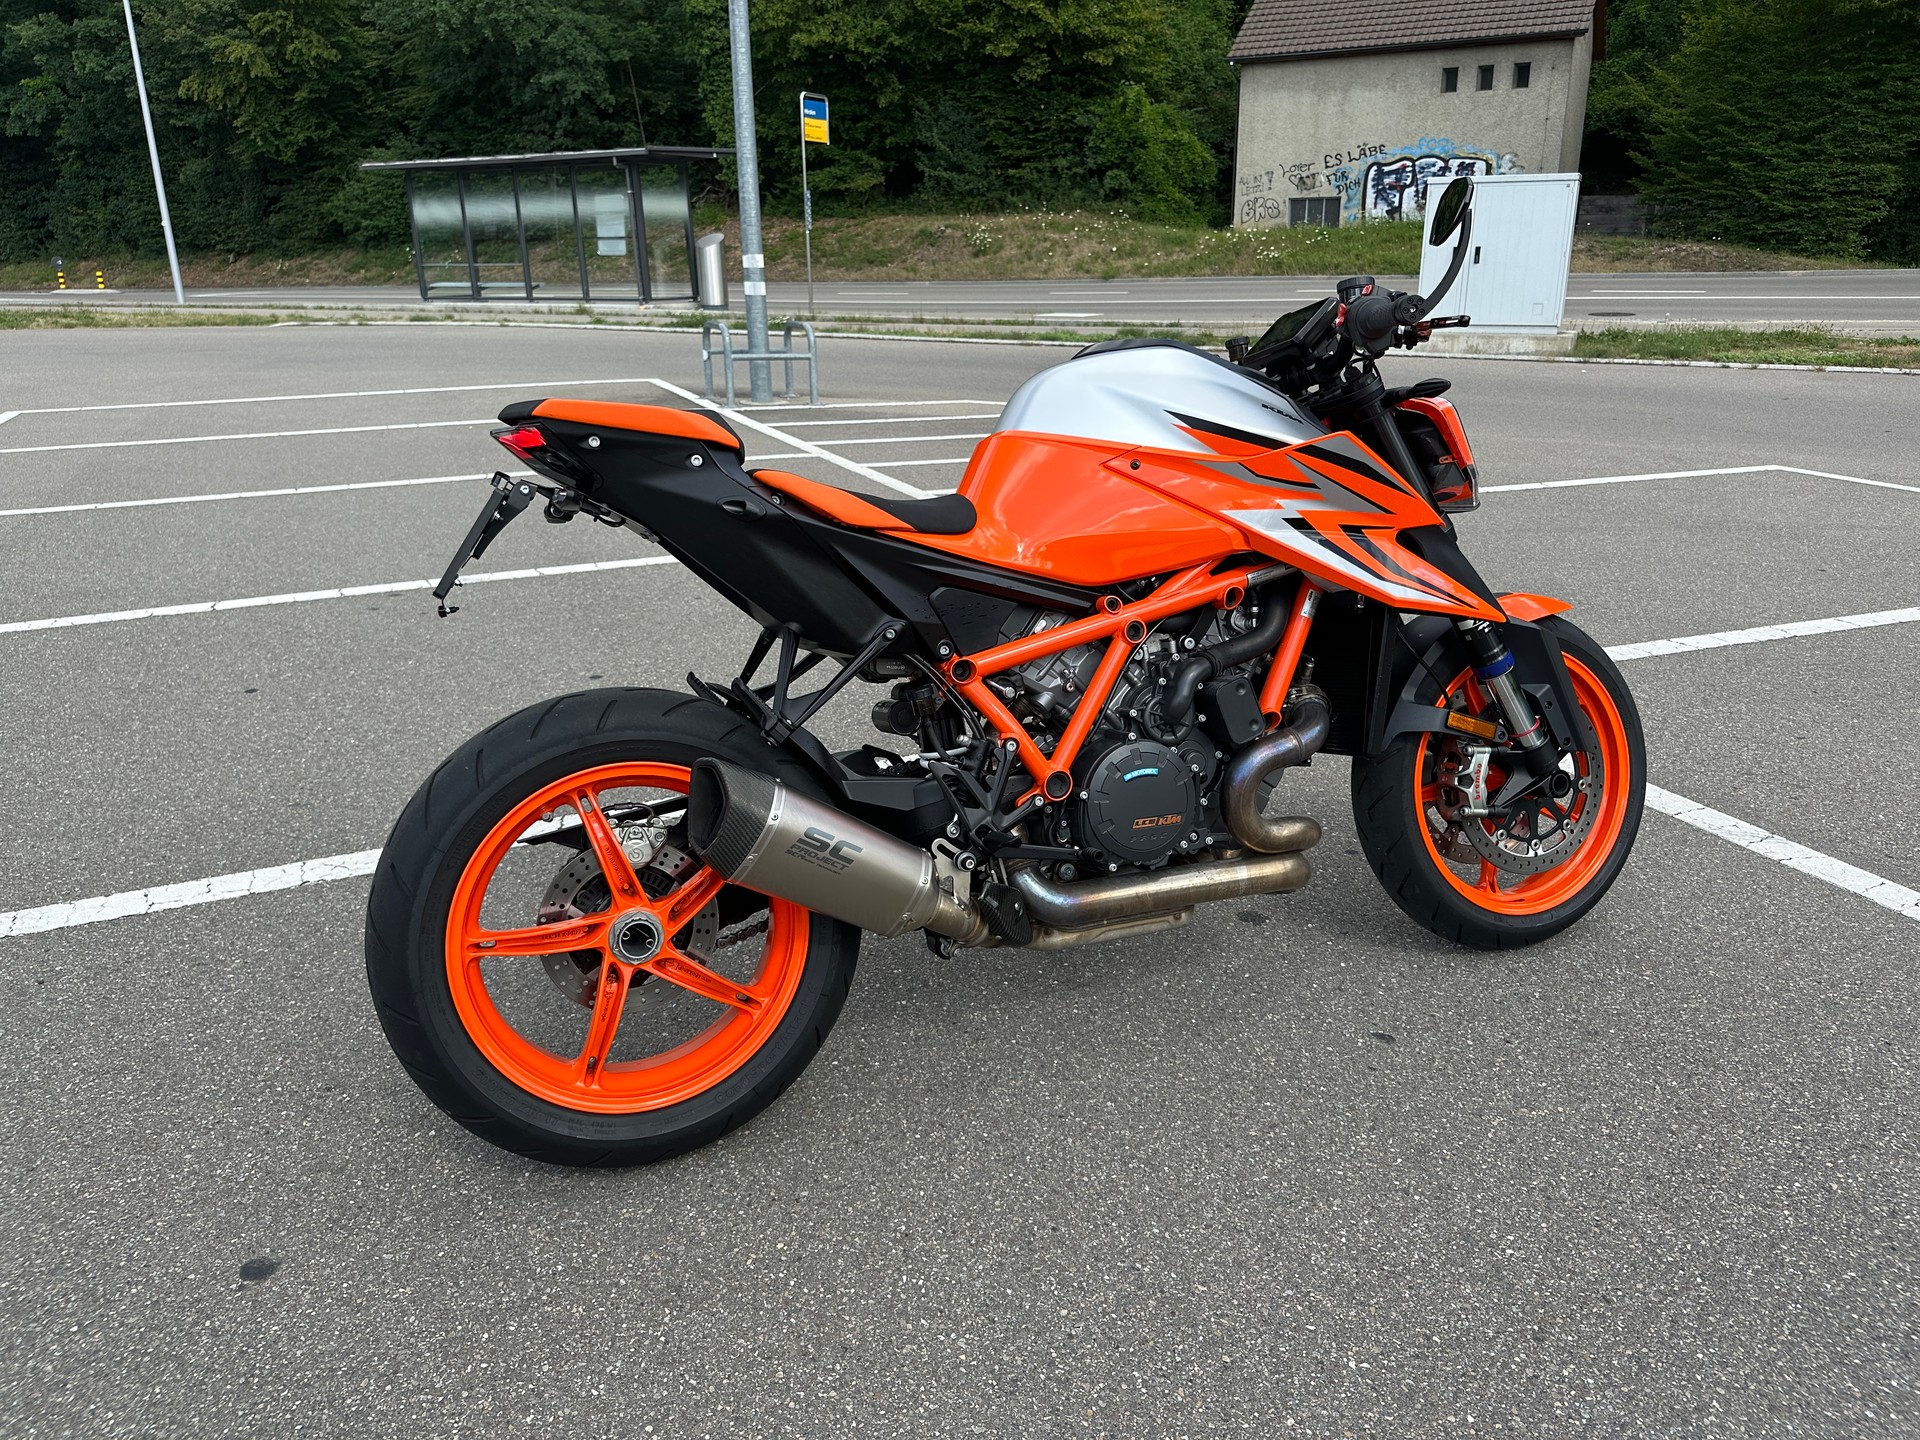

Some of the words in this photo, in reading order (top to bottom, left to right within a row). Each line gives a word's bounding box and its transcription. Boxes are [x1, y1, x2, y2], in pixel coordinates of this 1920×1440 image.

[1323, 153, 1343, 169] ES
[1347, 143, 1388, 162] LÄBE
[1335, 177, 1361, 195] DICH
[1474, 763, 1483, 801] brembo
[1157, 814, 1182, 826] KTM
[789, 843, 850, 871] PROJECT
[796, 826, 864, 866] SC
